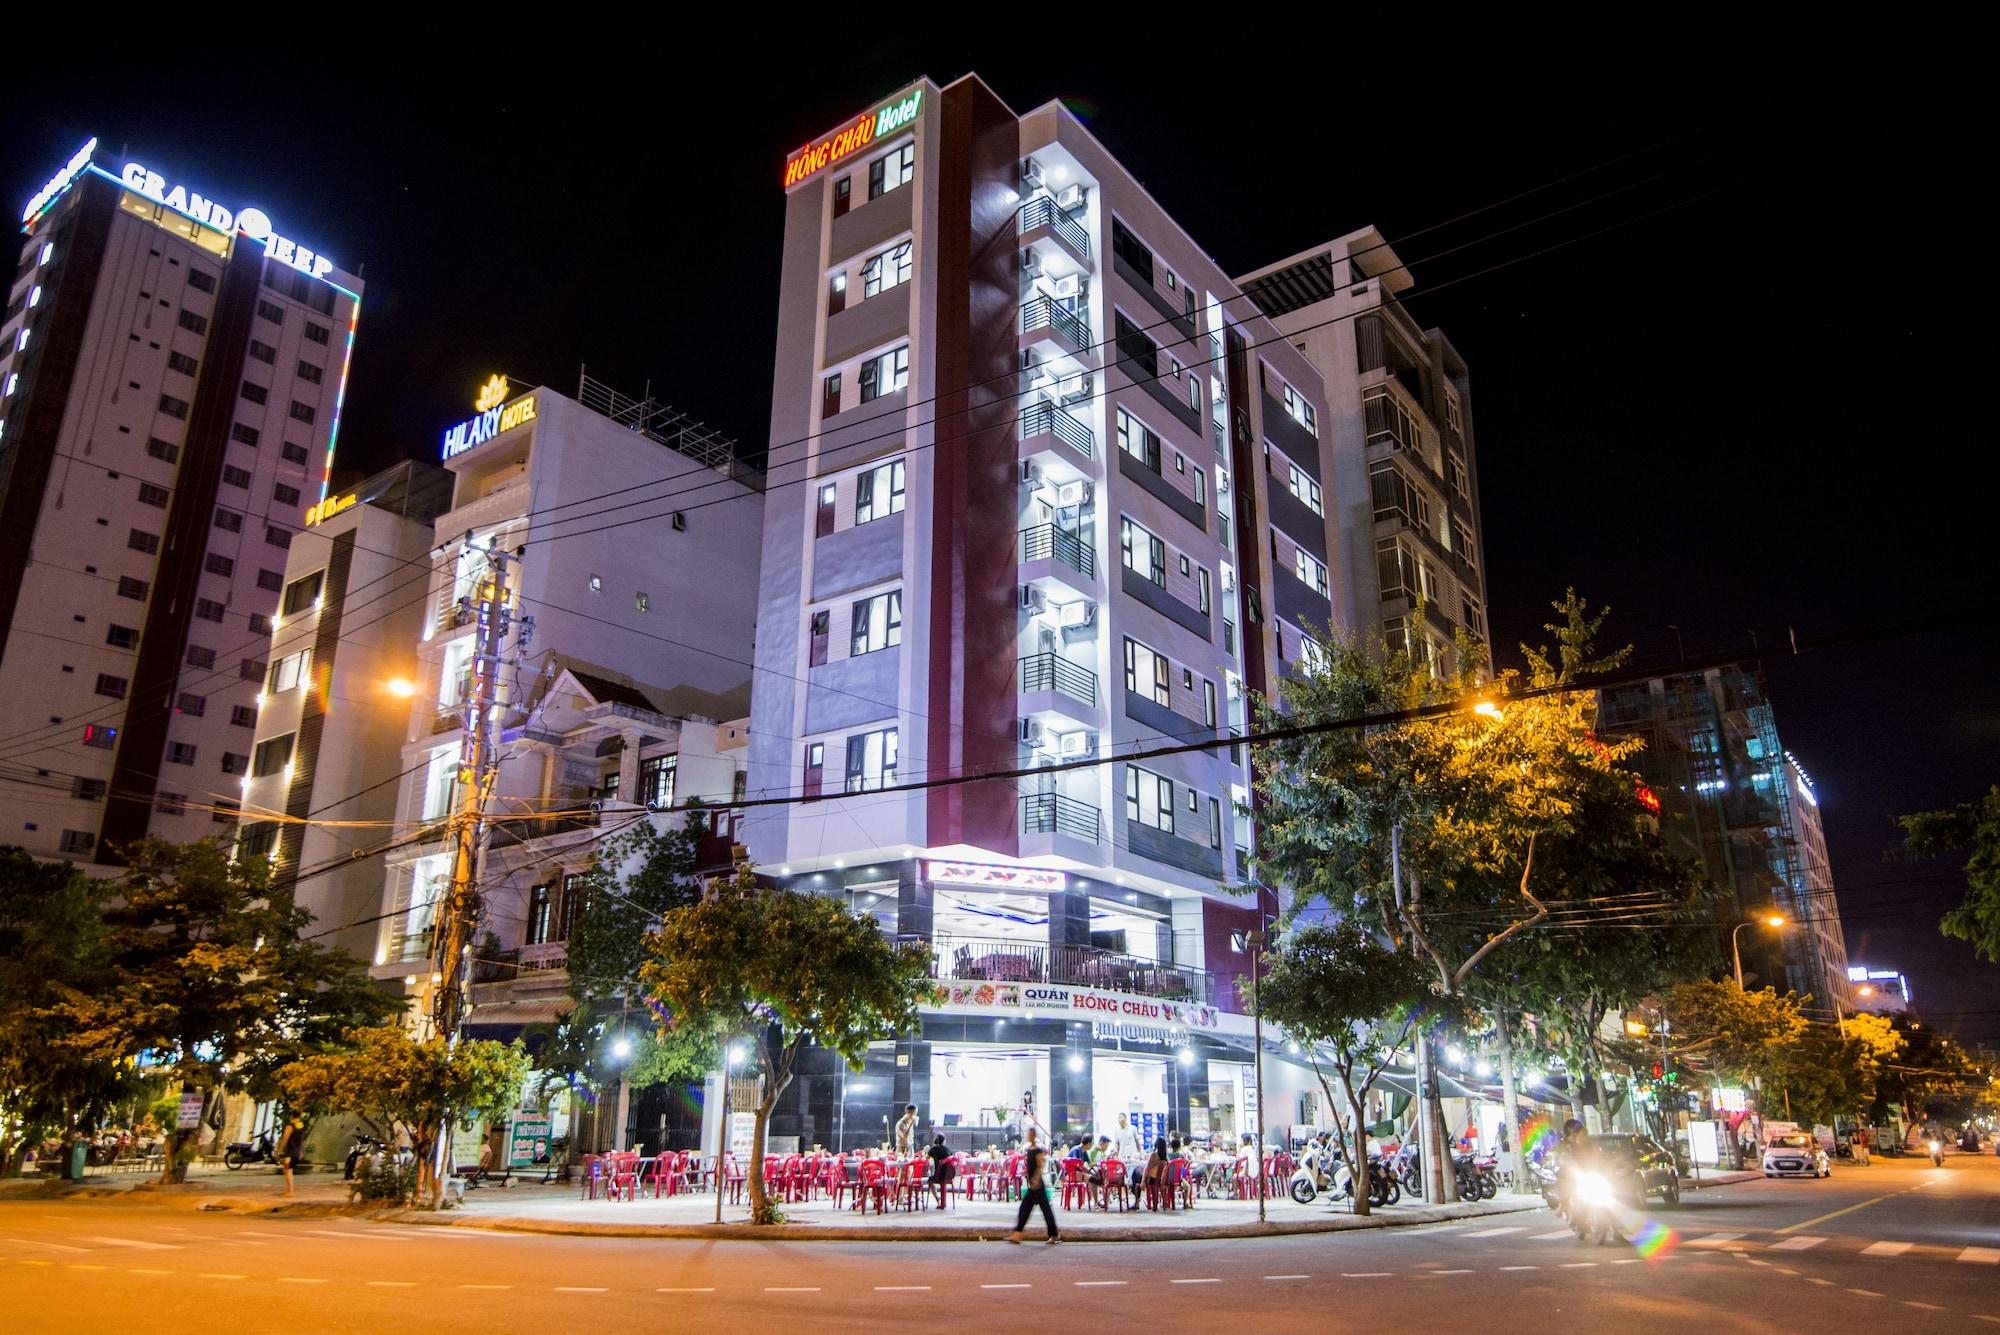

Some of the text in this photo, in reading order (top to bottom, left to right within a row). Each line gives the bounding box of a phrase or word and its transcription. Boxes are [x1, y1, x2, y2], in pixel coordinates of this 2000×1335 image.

[785, 89, 922, 186] HỒNG CHÂU Hotel
[122, 163, 233, 232] GRAND
[442, 396, 537, 460] HILARY HOTEL
[1025, 988, 1069, 1000] QUÁN
